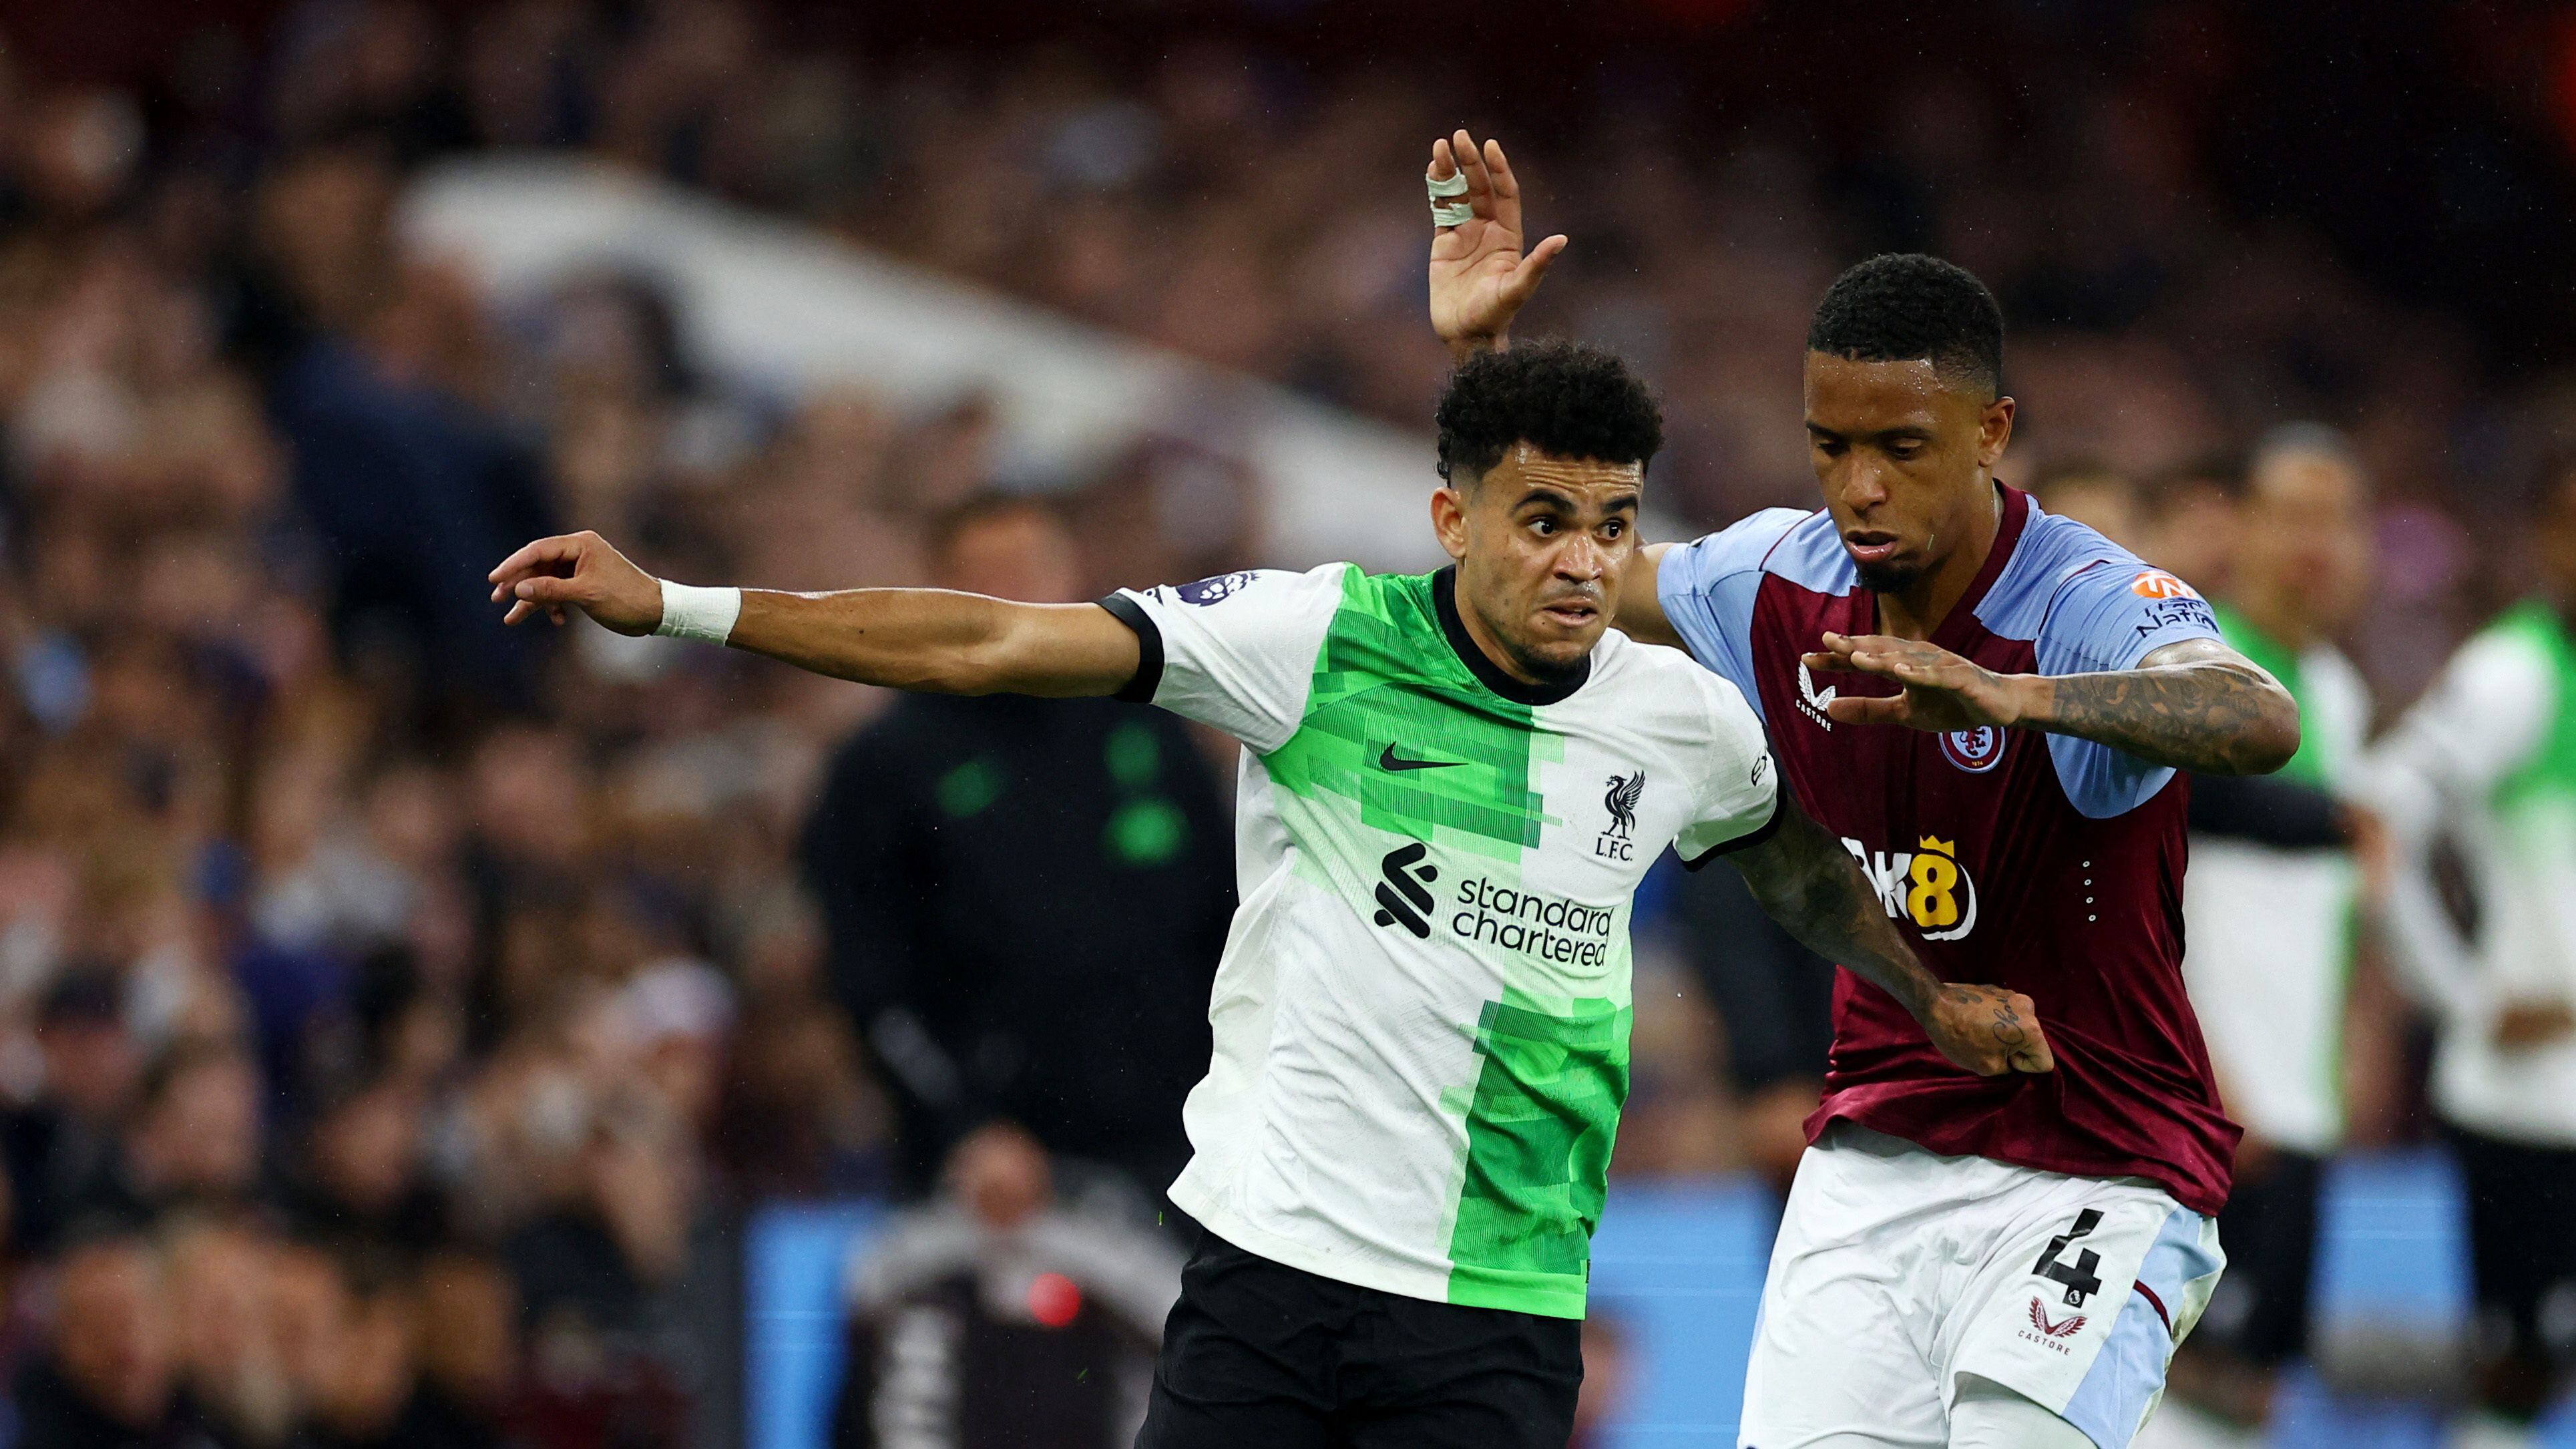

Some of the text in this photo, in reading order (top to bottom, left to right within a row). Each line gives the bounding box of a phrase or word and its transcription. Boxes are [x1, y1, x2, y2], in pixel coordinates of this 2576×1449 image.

[1795, 698, 1832, 732] CASTORE
[1595, 837, 1633, 861] L.F.C.
[1457, 876, 1614, 938] standard
[1452, 909, 1608, 967] chartered
[2031, 1208, 2105, 1309] 4
[2018, 1329, 2071, 1356] CASTORE
